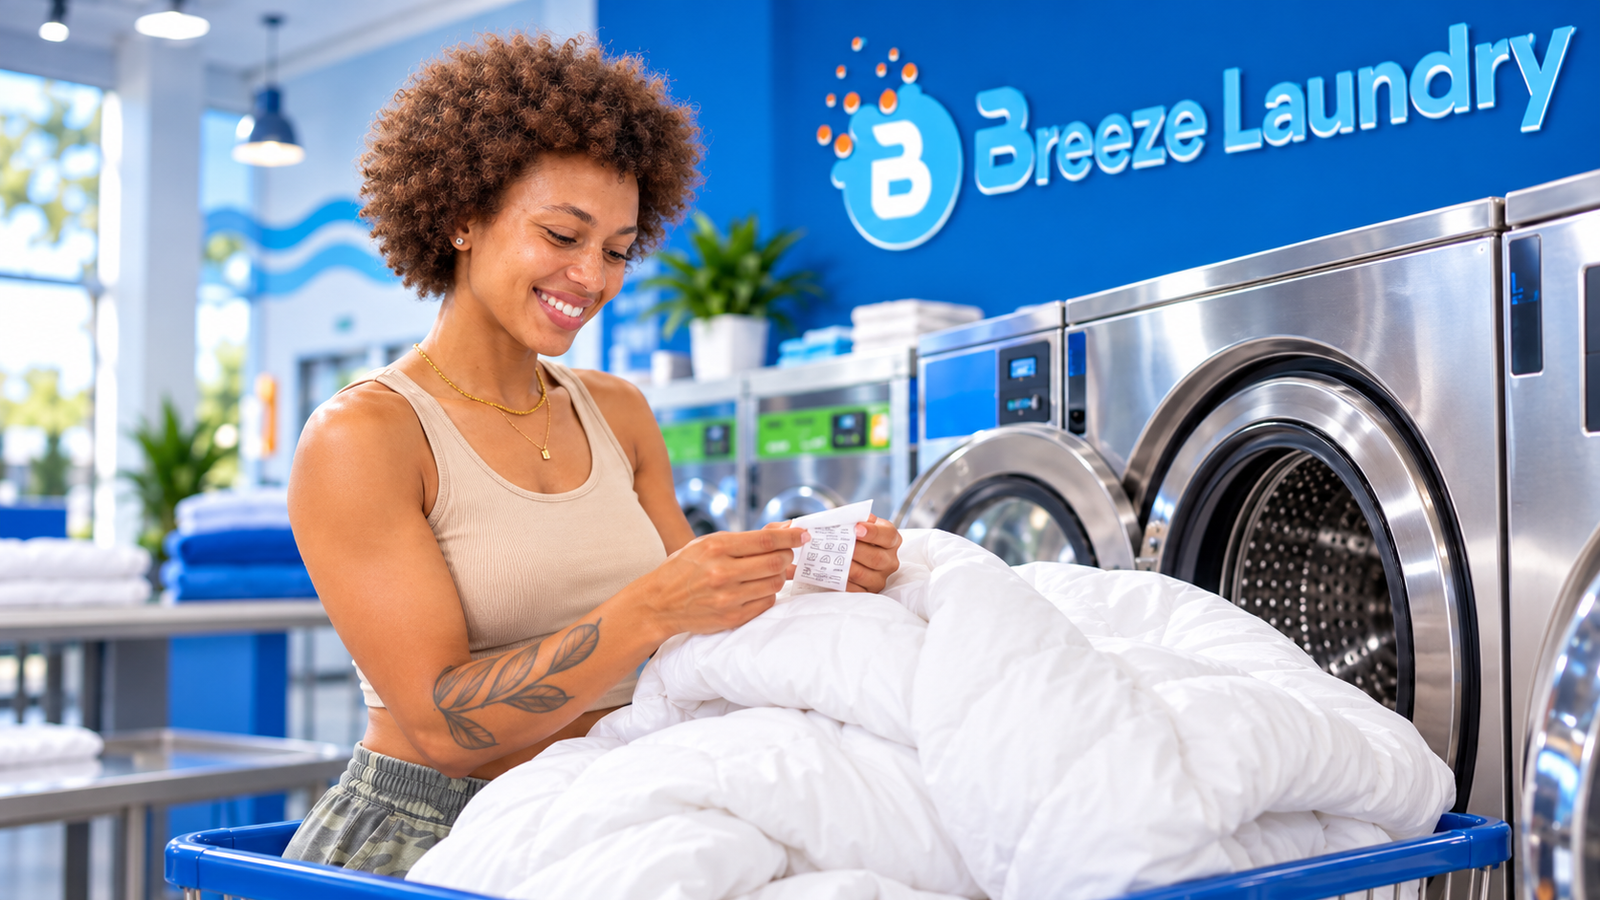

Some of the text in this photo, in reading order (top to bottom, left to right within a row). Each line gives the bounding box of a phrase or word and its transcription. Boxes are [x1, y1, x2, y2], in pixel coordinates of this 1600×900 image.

[871, 120, 932, 219] B
[975, 23, 1577, 196] Breeze Laundry
